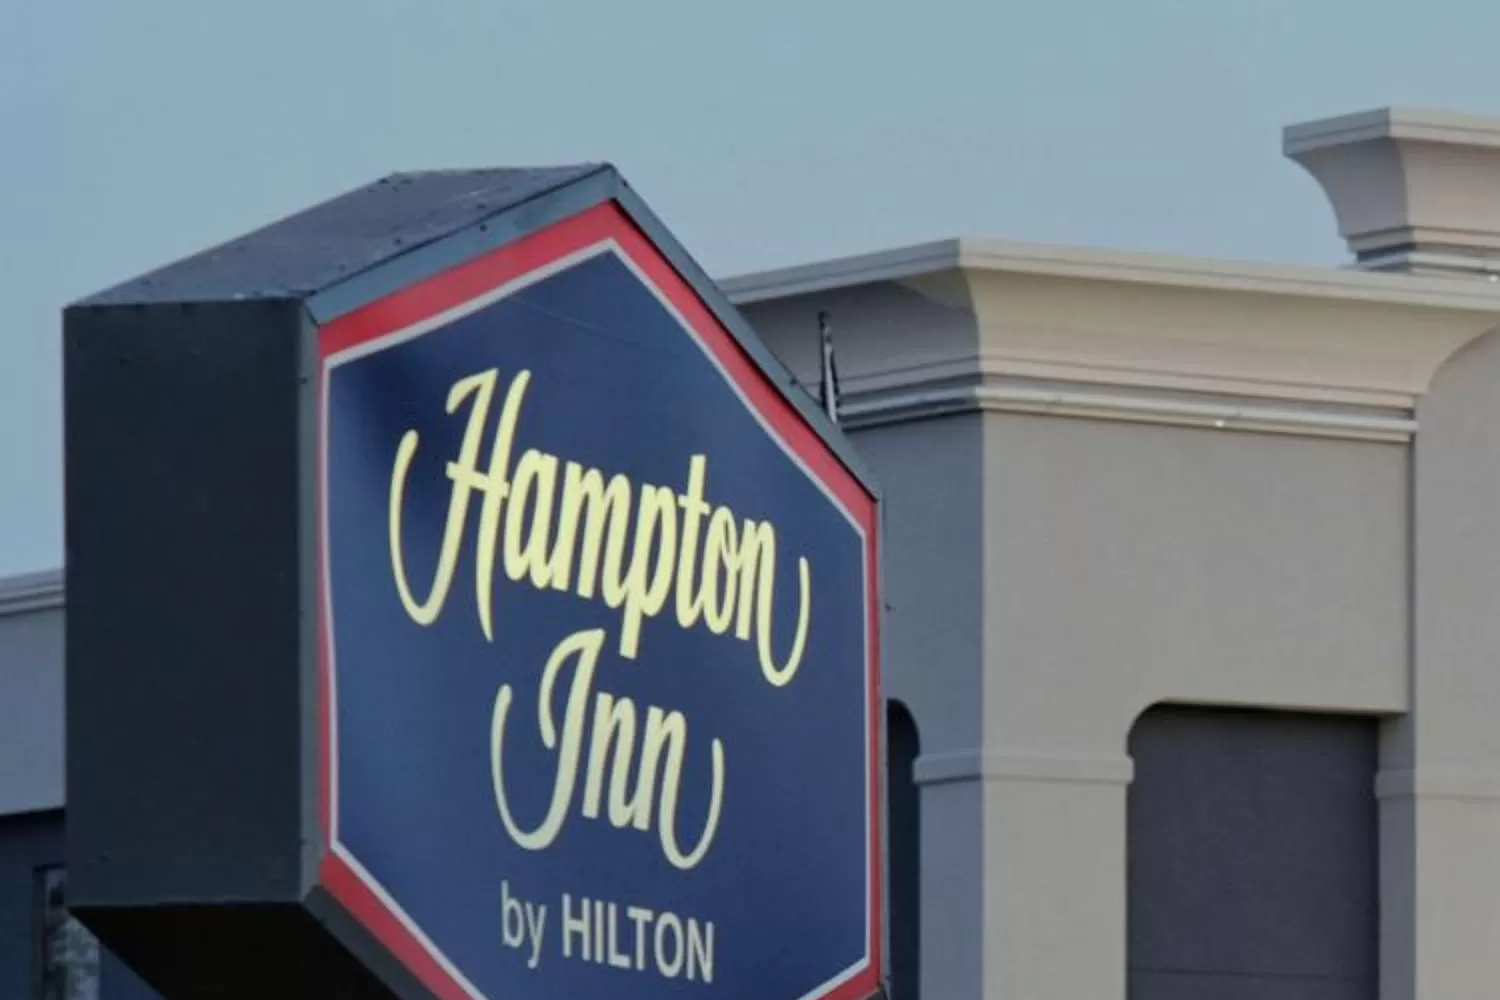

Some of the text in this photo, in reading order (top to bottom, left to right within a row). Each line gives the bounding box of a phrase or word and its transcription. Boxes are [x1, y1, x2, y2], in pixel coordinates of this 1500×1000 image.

[389, 367, 810, 687] Hampton
[491, 628, 724, 870] Inn
[501, 880, 715, 984] by HILTON
